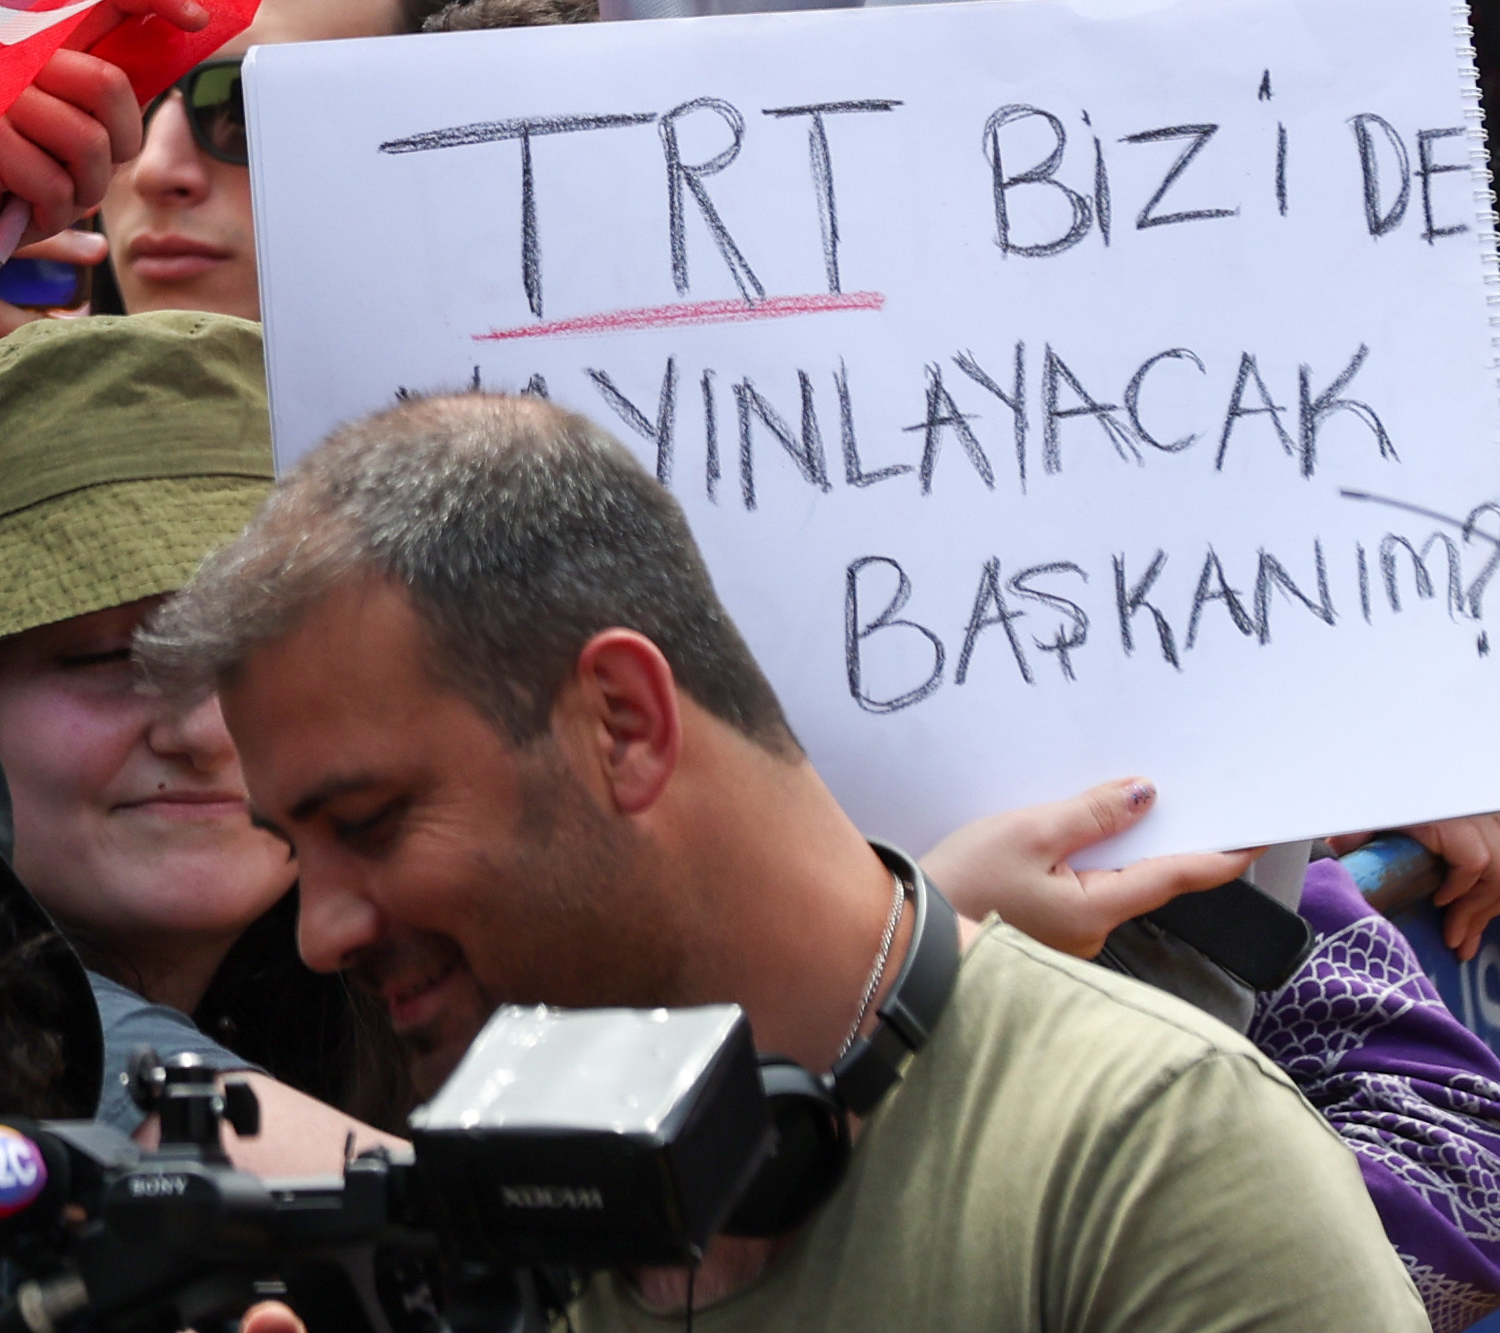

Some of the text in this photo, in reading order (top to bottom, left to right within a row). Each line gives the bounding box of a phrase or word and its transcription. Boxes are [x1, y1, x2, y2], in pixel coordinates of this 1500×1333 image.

[378, 97, 903, 317] TRT
[1346, 111, 1474, 245] DE
[394, 341, 1400, 510] YINLAYACAK
